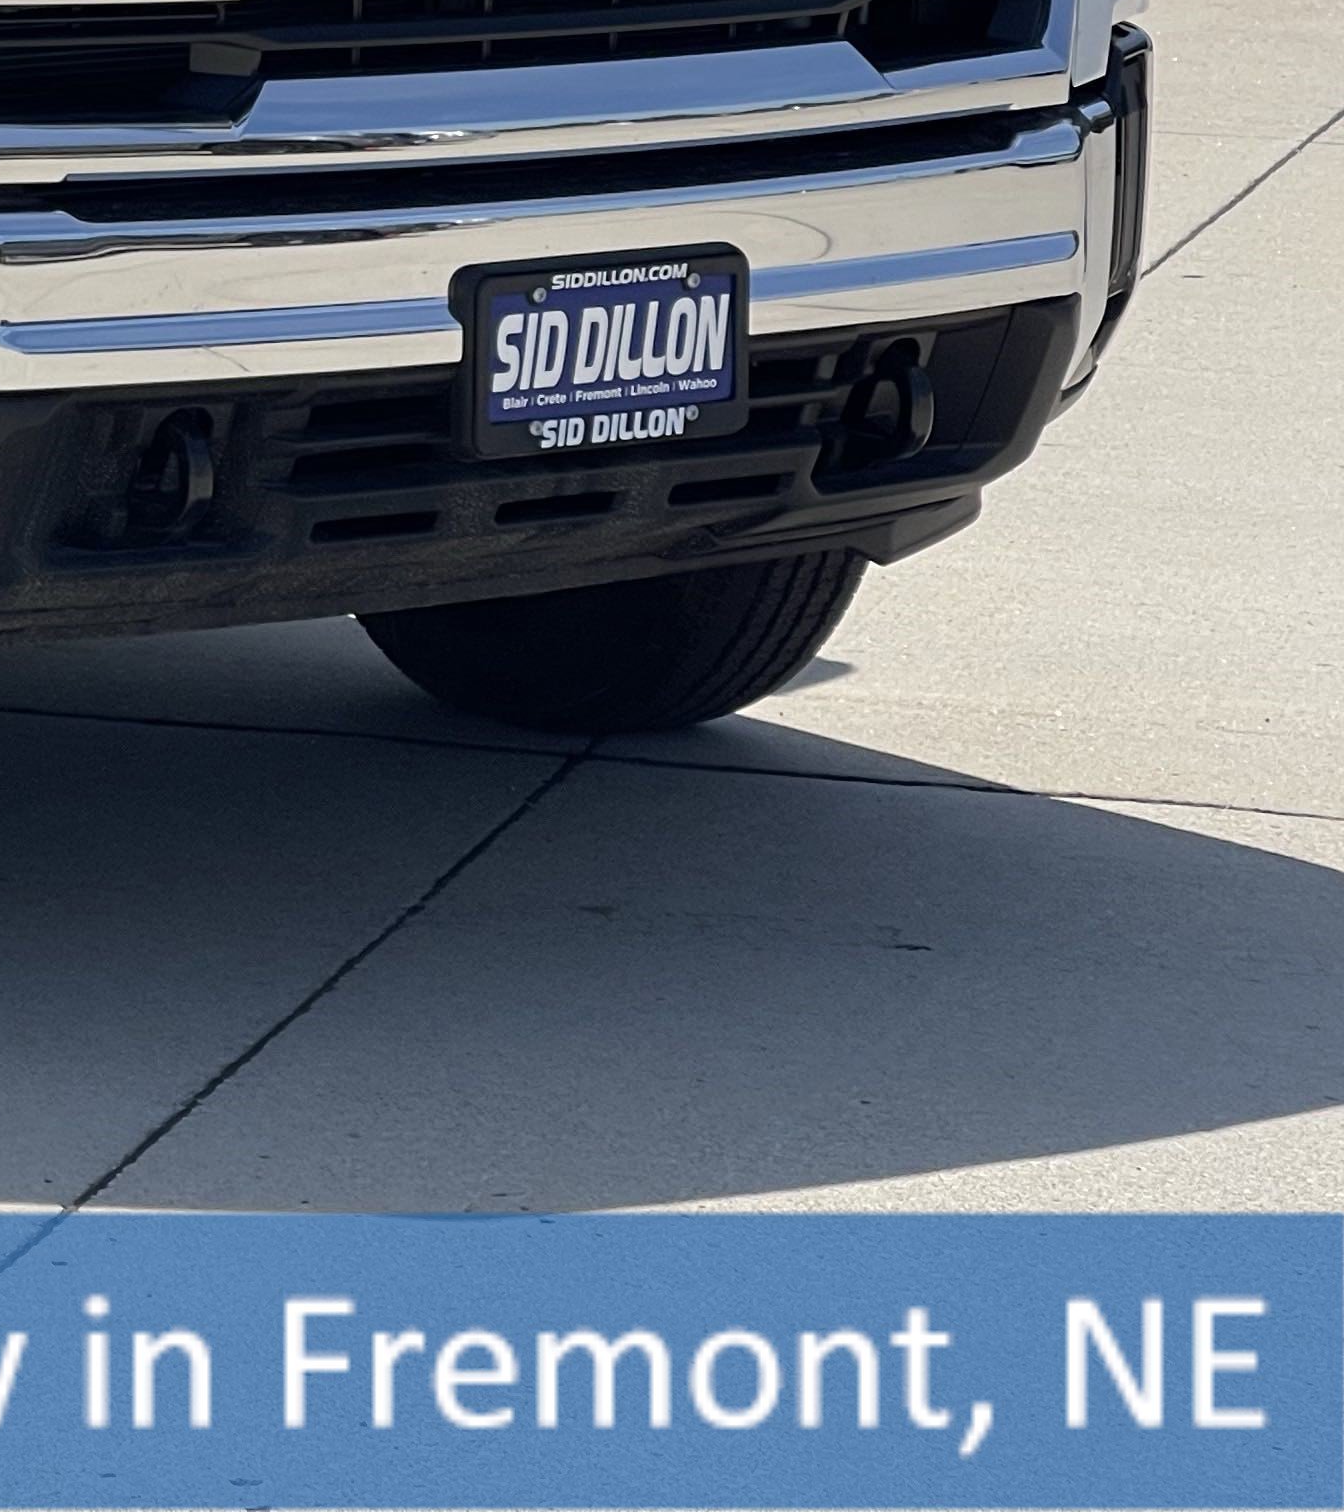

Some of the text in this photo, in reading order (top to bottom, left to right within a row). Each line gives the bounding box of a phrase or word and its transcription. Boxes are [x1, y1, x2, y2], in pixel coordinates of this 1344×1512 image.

[551, 263, 688, 290] SIDDILLON.COM
[491, 293, 730, 393] SID DILLON
[503, 378, 718, 410] Blair Crete Fremont Lincoln Wahoo
[541, 407, 686, 449] SID DILLON
